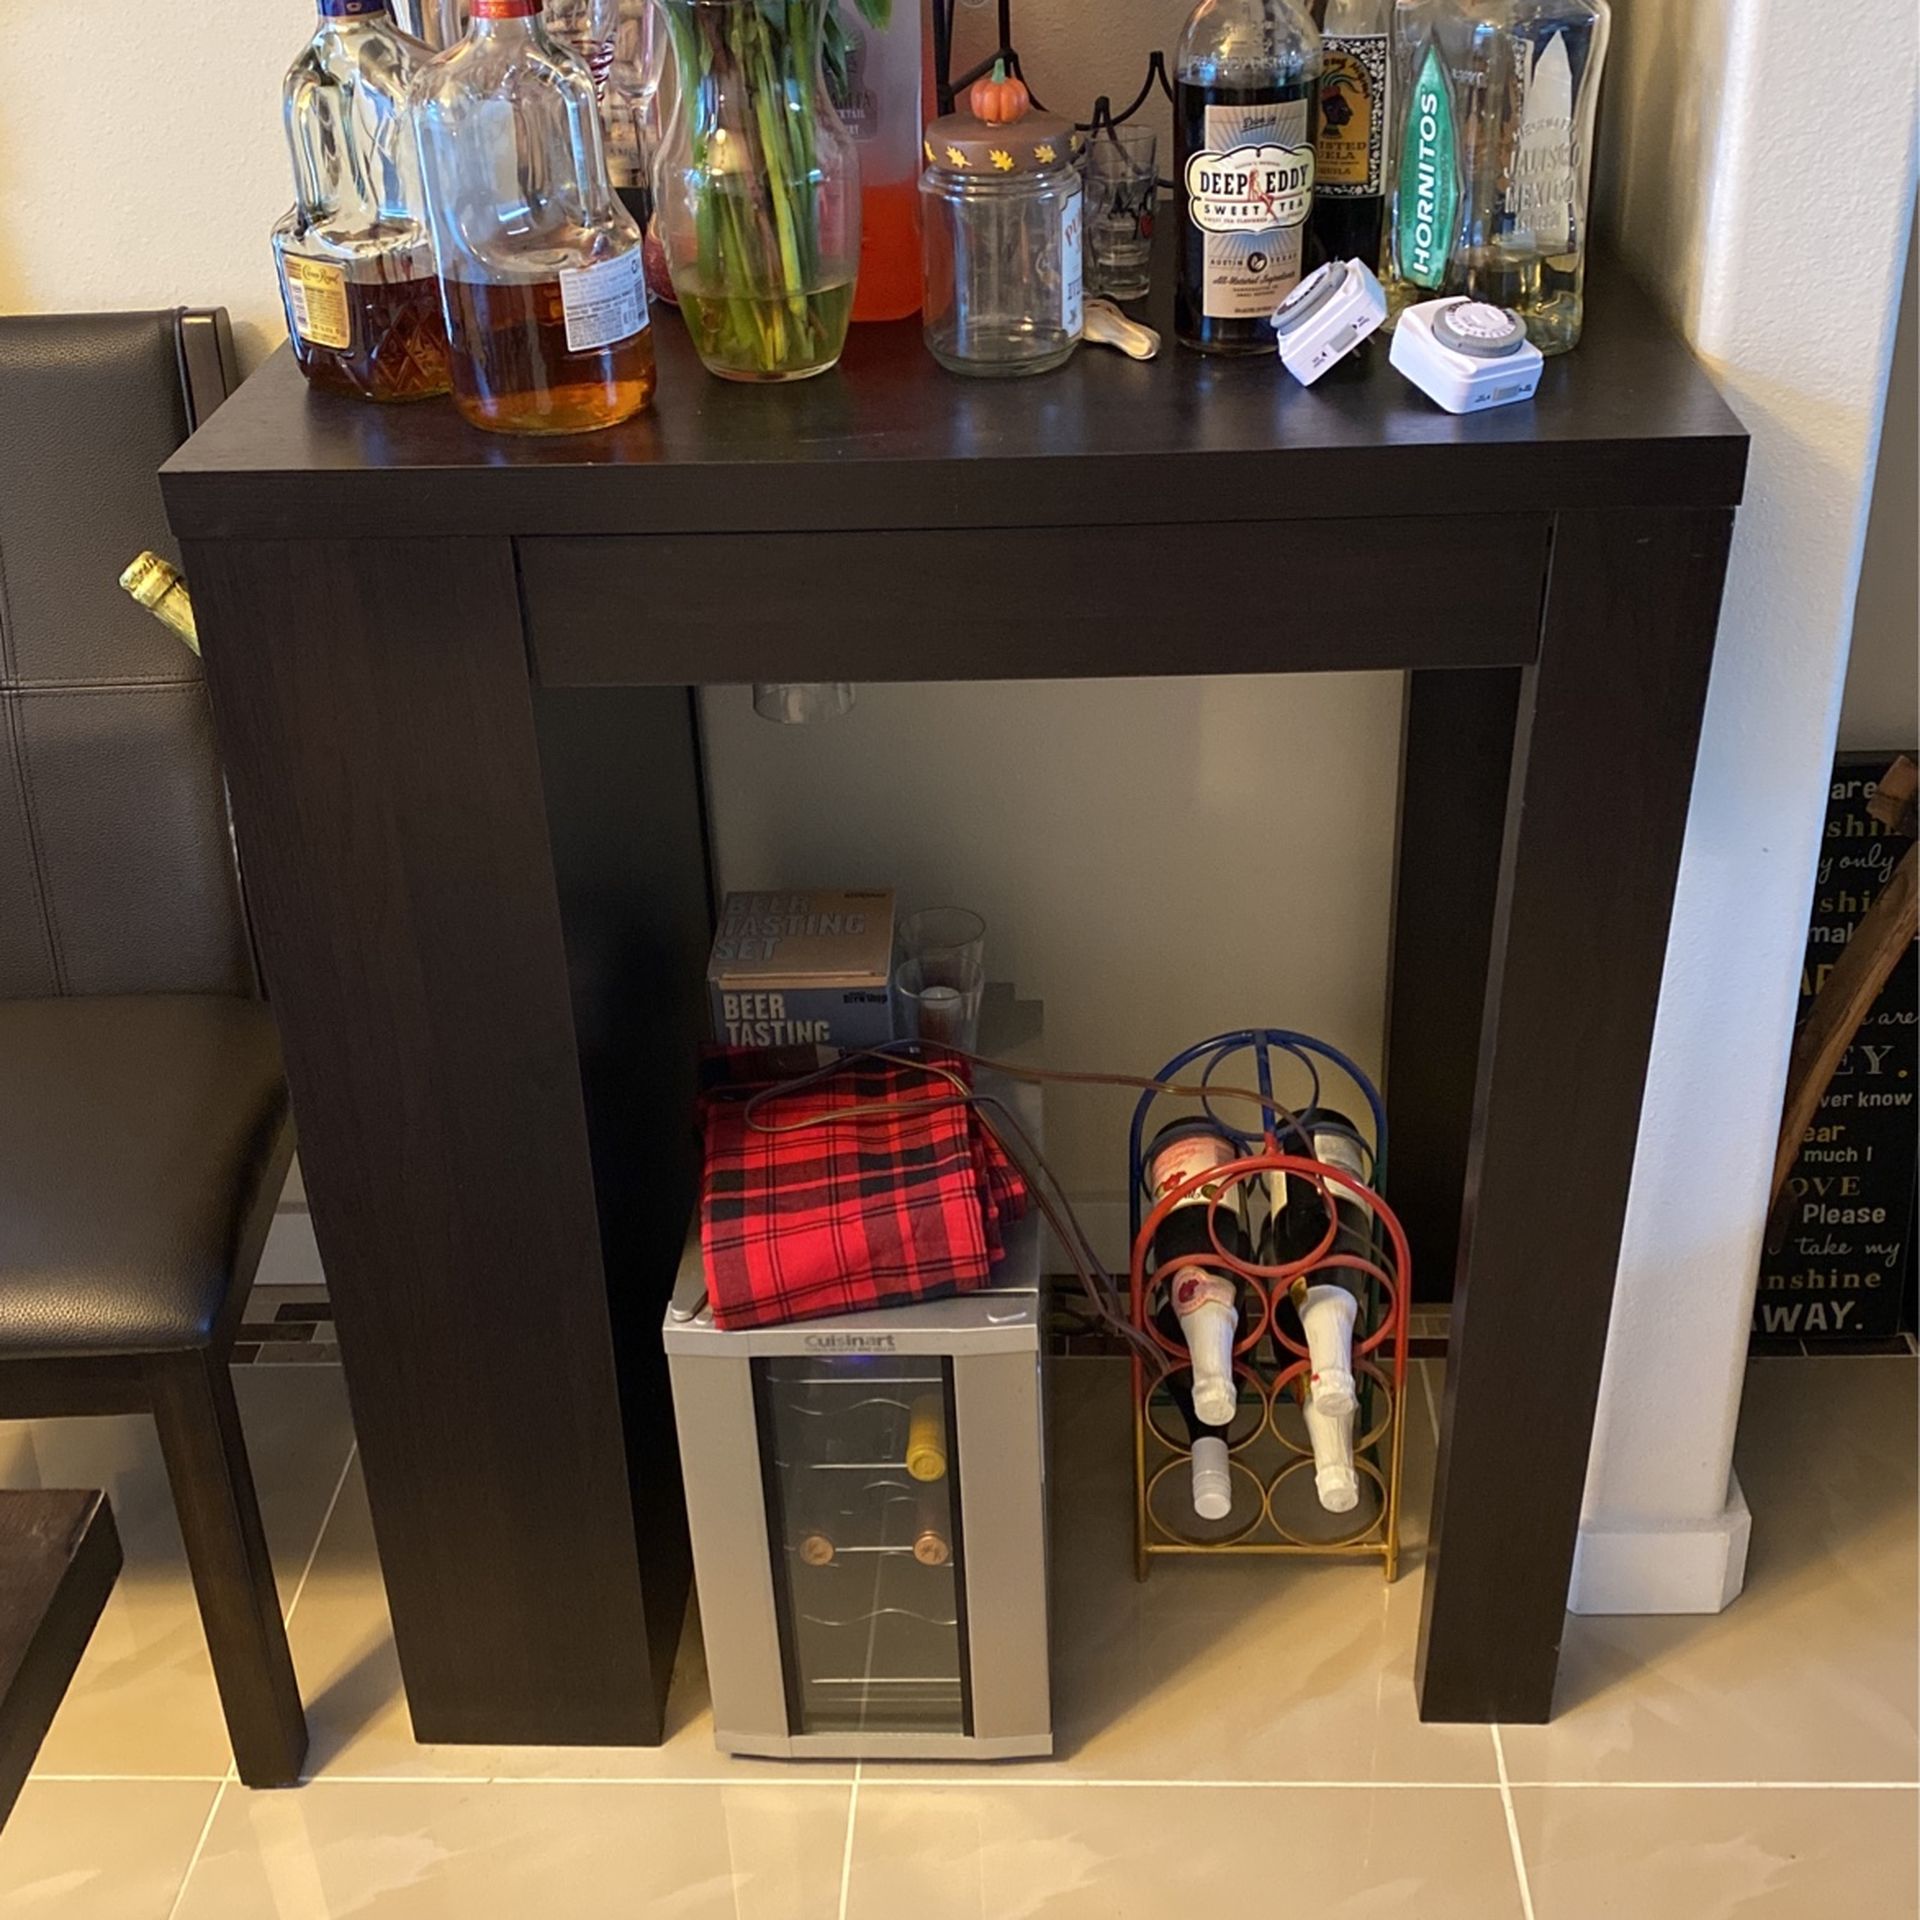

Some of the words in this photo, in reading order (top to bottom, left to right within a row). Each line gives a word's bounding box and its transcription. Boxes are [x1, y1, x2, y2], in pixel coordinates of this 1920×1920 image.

[1200, 171, 1248, 195] DEEP
[1266, 164, 1309, 195] EDDY
[1413, 93, 1438, 273] HORNITOS
[1204, 204, 1260, 216] SWEET
[1280, 198, 1304, 212] TEA
[1839, 843, 1894, 883] only
[722, 912, 866, 937] TASTING
[714, 936, 782, 961] SET
[722, 992, 786, 1021] BEER
[725, 1020, 831, 1048] TASTING
[1858, 1091, 1913, 1108] know
[1804, 1146, 1858, 1163] much
[1803, 1203, 1887, 1225] Please
[1794, 1234, 1853, 1256] take
[1866, 1242, 1901, 1268] my
[1759, 1269, 1882, 1290] nshine
[1751, 1301, 1864, 1333] WAY.
[804, 1334, 896, 1348] Cuisinart
